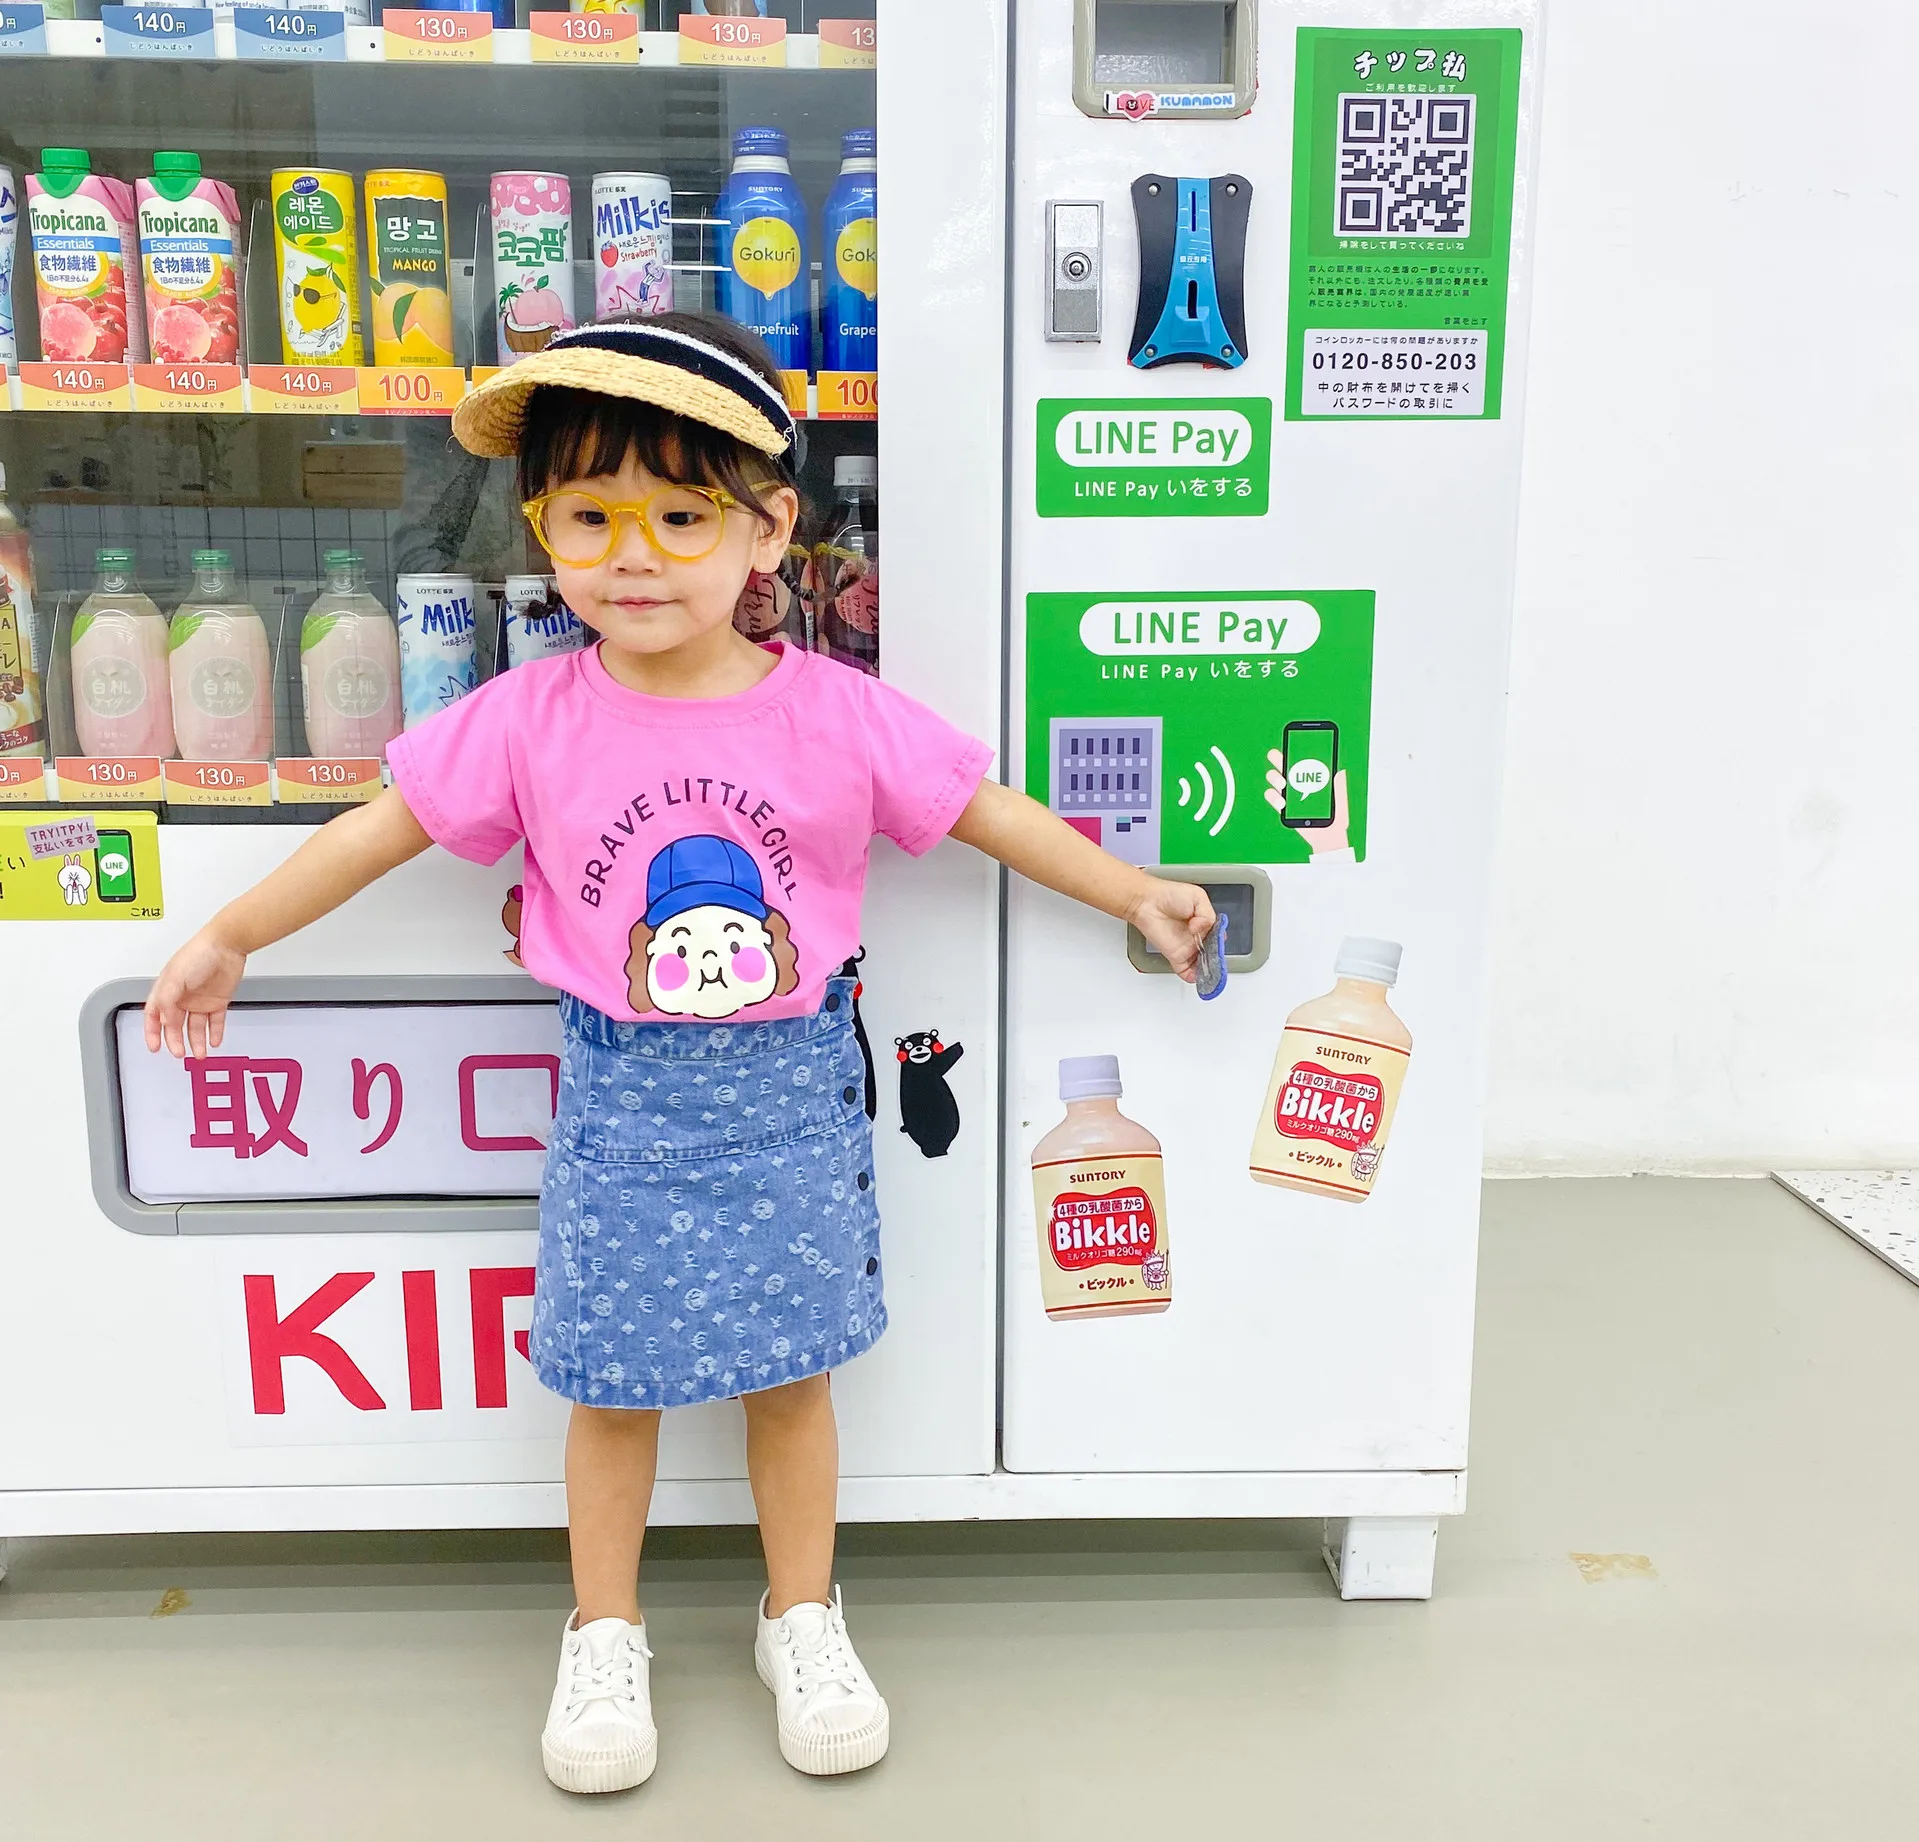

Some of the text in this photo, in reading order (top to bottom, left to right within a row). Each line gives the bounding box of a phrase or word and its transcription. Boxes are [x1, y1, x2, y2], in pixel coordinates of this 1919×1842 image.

[133, 12, 186, 33] 140円
[265, 15, 317, 36] 140円
[415, 17, 468, 39] 130円
[561, 18, 613, 40] 130円
[710, 22, 761, 44] 130円
[408, 48, 475, 58] じどうはんばいき
[555, 49, 621, 59] じどうはんばいき
[703, 53, 767, 63] じどうはんばいき
[1354, 48, 1467, 81] チップ払
[1161, 95, 1233, 106] KUMAMON
[288, 197, 325, 216] 레몬
[30, 208, 106, 234] Tropicana
[141, 210, 219, 236] Tropicana
[283, 215, 334, 231] 에이드
[597, 196, 670, 239] Milkis
[386, 217, 438, 242] 망고
[37, 238, 94, 250] Essentials
[150, 239, 208, 252] Essentials
[497, 227, 567, 268] 코코팜
[620, 247, 657, 263] Strawberry
[739, 247, 796, 263] Gokuri
[392, 258, 437, 272] MANGO
[1312, 352, 1477, 371] 0120-850-203
[52, 369, 105, 390] 140円
[165, 371, 217, 391] 140円
[280, 373, 332, 393] 140円
[378, 374, 443, 402] 100円
[47, 400, 113, 408] じどうはんばいき
[160, 401, 225, 409] じどうはんばいき
[1075, 421, 1239, 462] LINE Pay
[1075, 477, 1253, 500] LINE Pay いをする
[1114, 611, 1288, 650] LINE Pay
[1101, 660, 1299, 681] LINE Pay いをする
[92, 679, 131, 695] 白桃
[203, 679, 244, 695] 白桃
[337, 678, 378, 695] 白桃
[87, 764, 137, 781] 130円
[195, 768, 245, 786] 130円
[307, 765, 357, 782] 130円
[1295, 772, 1323, 783] LINE
[82, 791, 145, 799] じどうはんばいき
[189, 795, 252, 803] じどうはんばいき
[33, 833, 96, 855] 支払いをする
[580, 793, 655, 908] BRAVE
[105, 861, 124, 870] LINE
[130, 907, 161, 917] これは
[1316, 1046, 1372, 1065] SUNTORY
[1294, 1072, 1377, 1099] 4種の乳酸菌から
[183, 1054, 561, 1159] 取り口
[1280, 1086, 1375, 1134] Bikkle
[1296, 1151, 1336, 1169] ビックル
[1069, 1170, 1126, 1183] SUNTORY
[1059, 1198, 1143, 1216] 4種の乳酸菌から
[1055, 1214, 1150, 1251] Bikkle
[1087, 1277, 1127, 1290] ビックル
